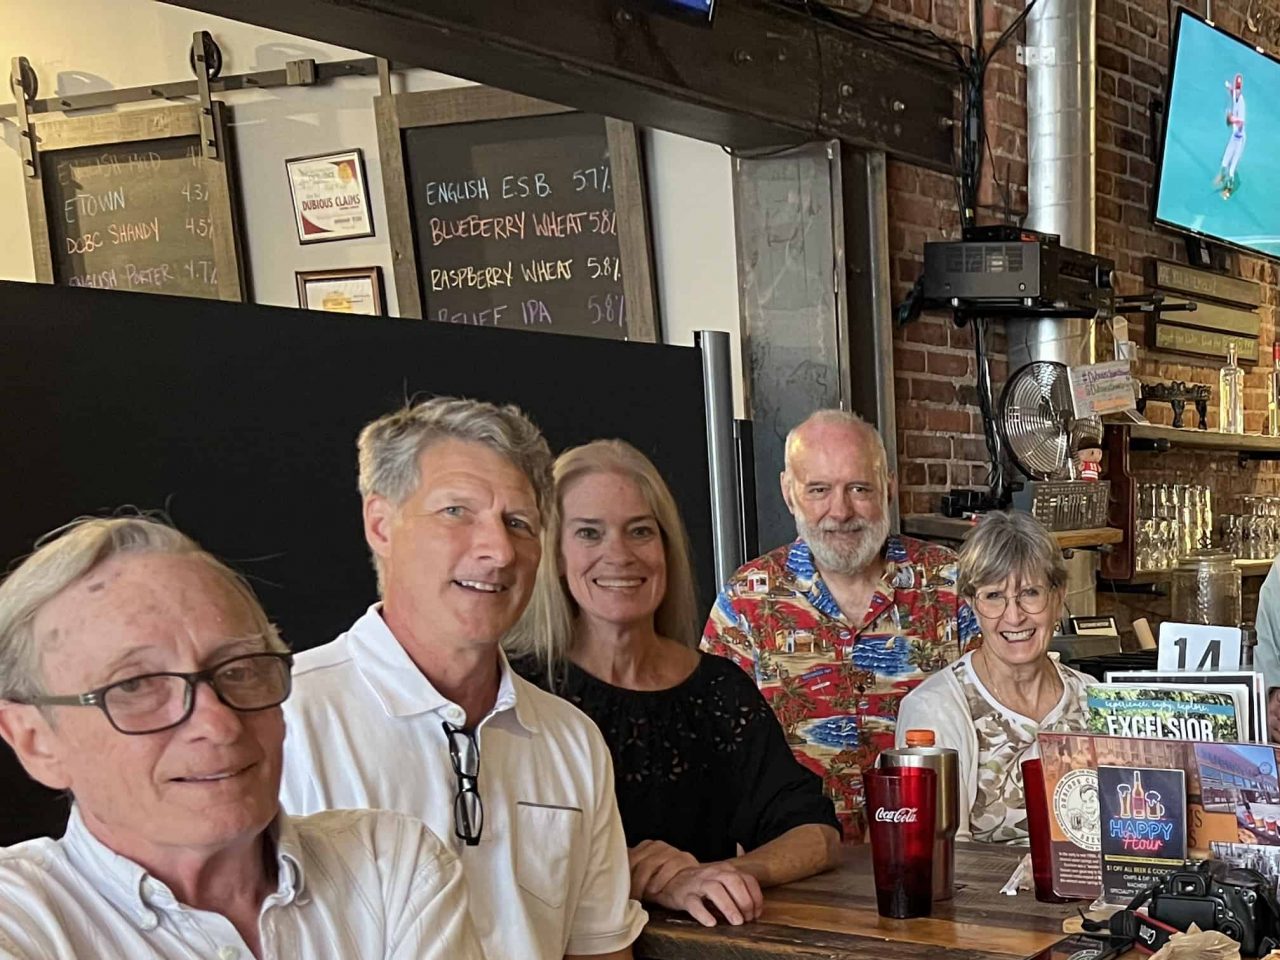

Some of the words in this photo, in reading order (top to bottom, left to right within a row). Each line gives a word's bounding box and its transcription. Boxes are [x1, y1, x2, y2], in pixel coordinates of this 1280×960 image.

[302, 198, 333, 211] DUBIOUS
[335, 194, 361, 207] CLAIMS
[426, 177, 489, 206] ENGLISH
[108, 217, 160, 244] SHANDY
[430, 211, 525, 245] BLUEBERRY
[533, 211, 587, 238] WHEAT
[125, 263, 174, 288] PORTER
[431, 261, 513, 291] RASPBERRY
[521, 258, 573, 282] WHEAT
[587, 256, 621, 281] 5.8%
[521, 300, 552, 324] IPA
[1174, 637, 1221, 672] 14
[1107, 715, 1214, 742] EXCELSIOR
[875, 807, 918, 823] Coca-Cola
[1109, 819, 1173, 841] HAPPY
[1122, 831, 1164, 850] Hour
